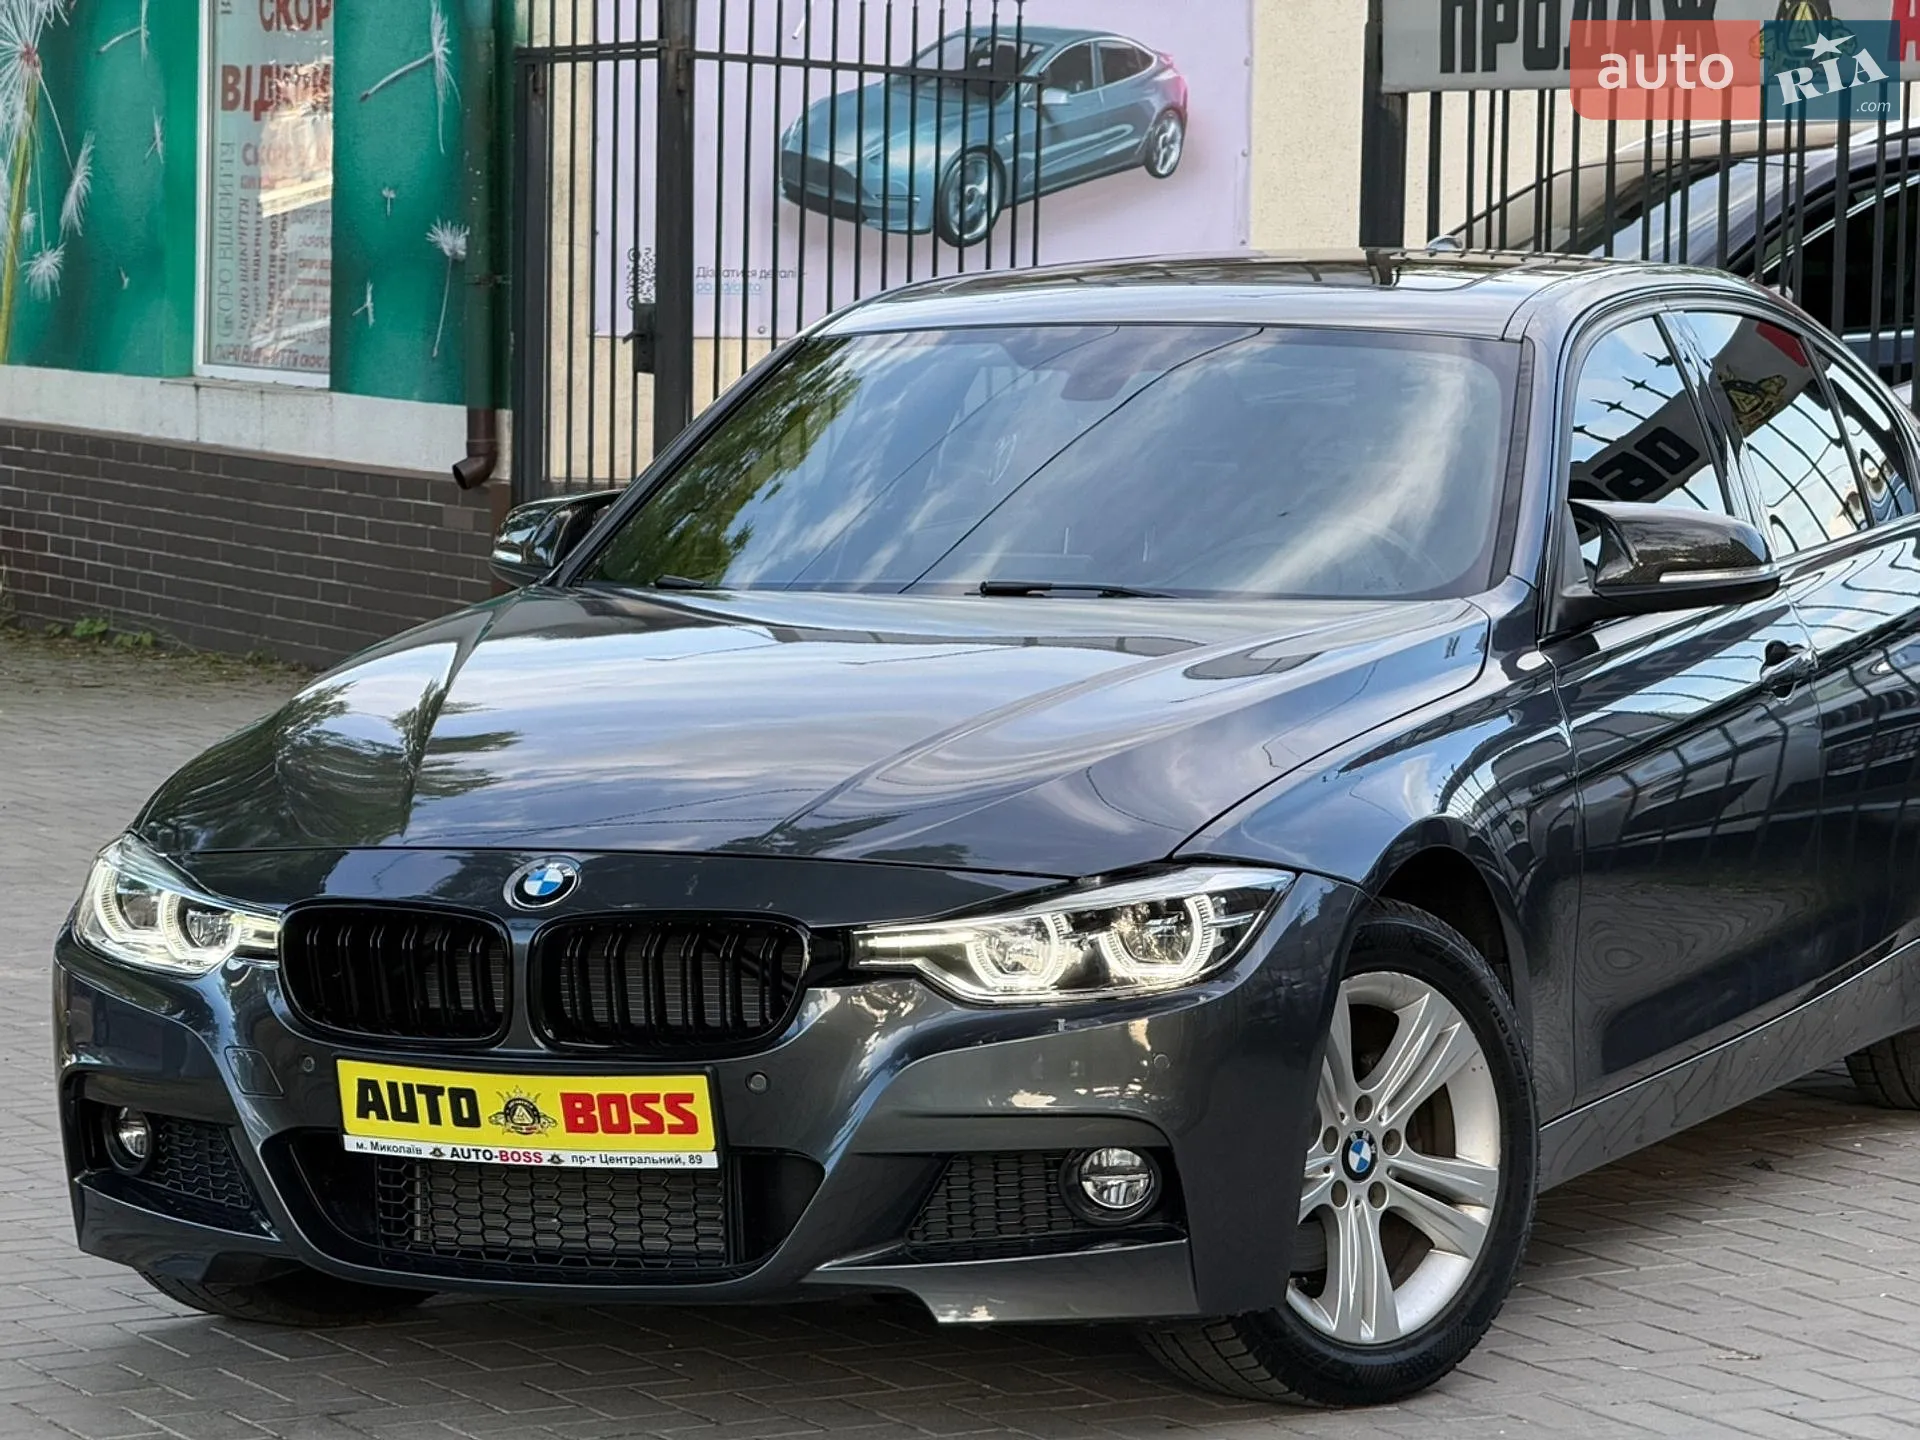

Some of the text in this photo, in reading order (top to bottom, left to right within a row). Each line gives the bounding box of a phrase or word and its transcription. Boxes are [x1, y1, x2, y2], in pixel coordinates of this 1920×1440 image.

[1440, 0, 1722, 73] ПРОДАЖ
[696, 266, 757, 278] Дізатия
[357, 1078, 699, 1135] AUTO BOSS
[355, 1140, 703, 1166] м. Миколаїв AUTO-BOSS пр-т Центральний, 89
